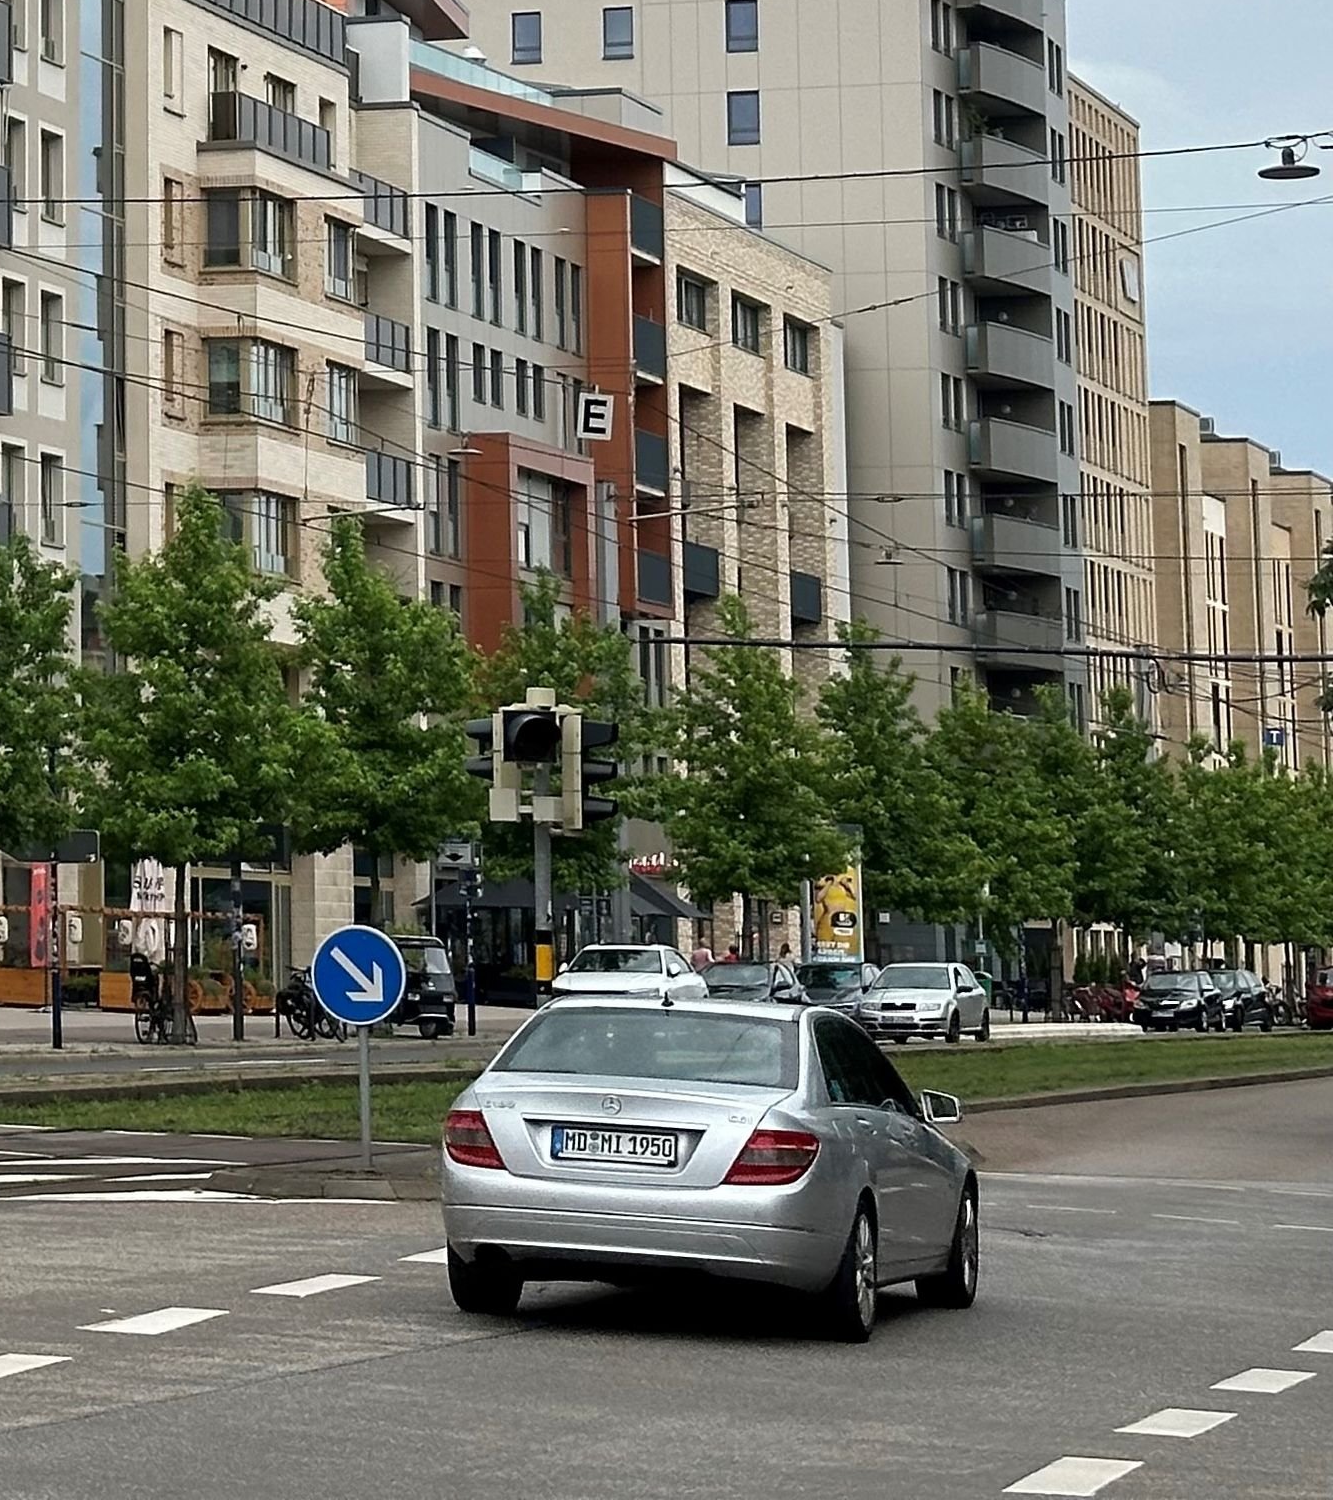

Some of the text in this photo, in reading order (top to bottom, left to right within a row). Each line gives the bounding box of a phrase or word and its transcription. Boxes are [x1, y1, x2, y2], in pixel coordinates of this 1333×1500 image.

[582, 399, 608, 434] E
[1269, 730, 1281, 743] T
[565, 1131, 673, 1158] MD MI 1950
